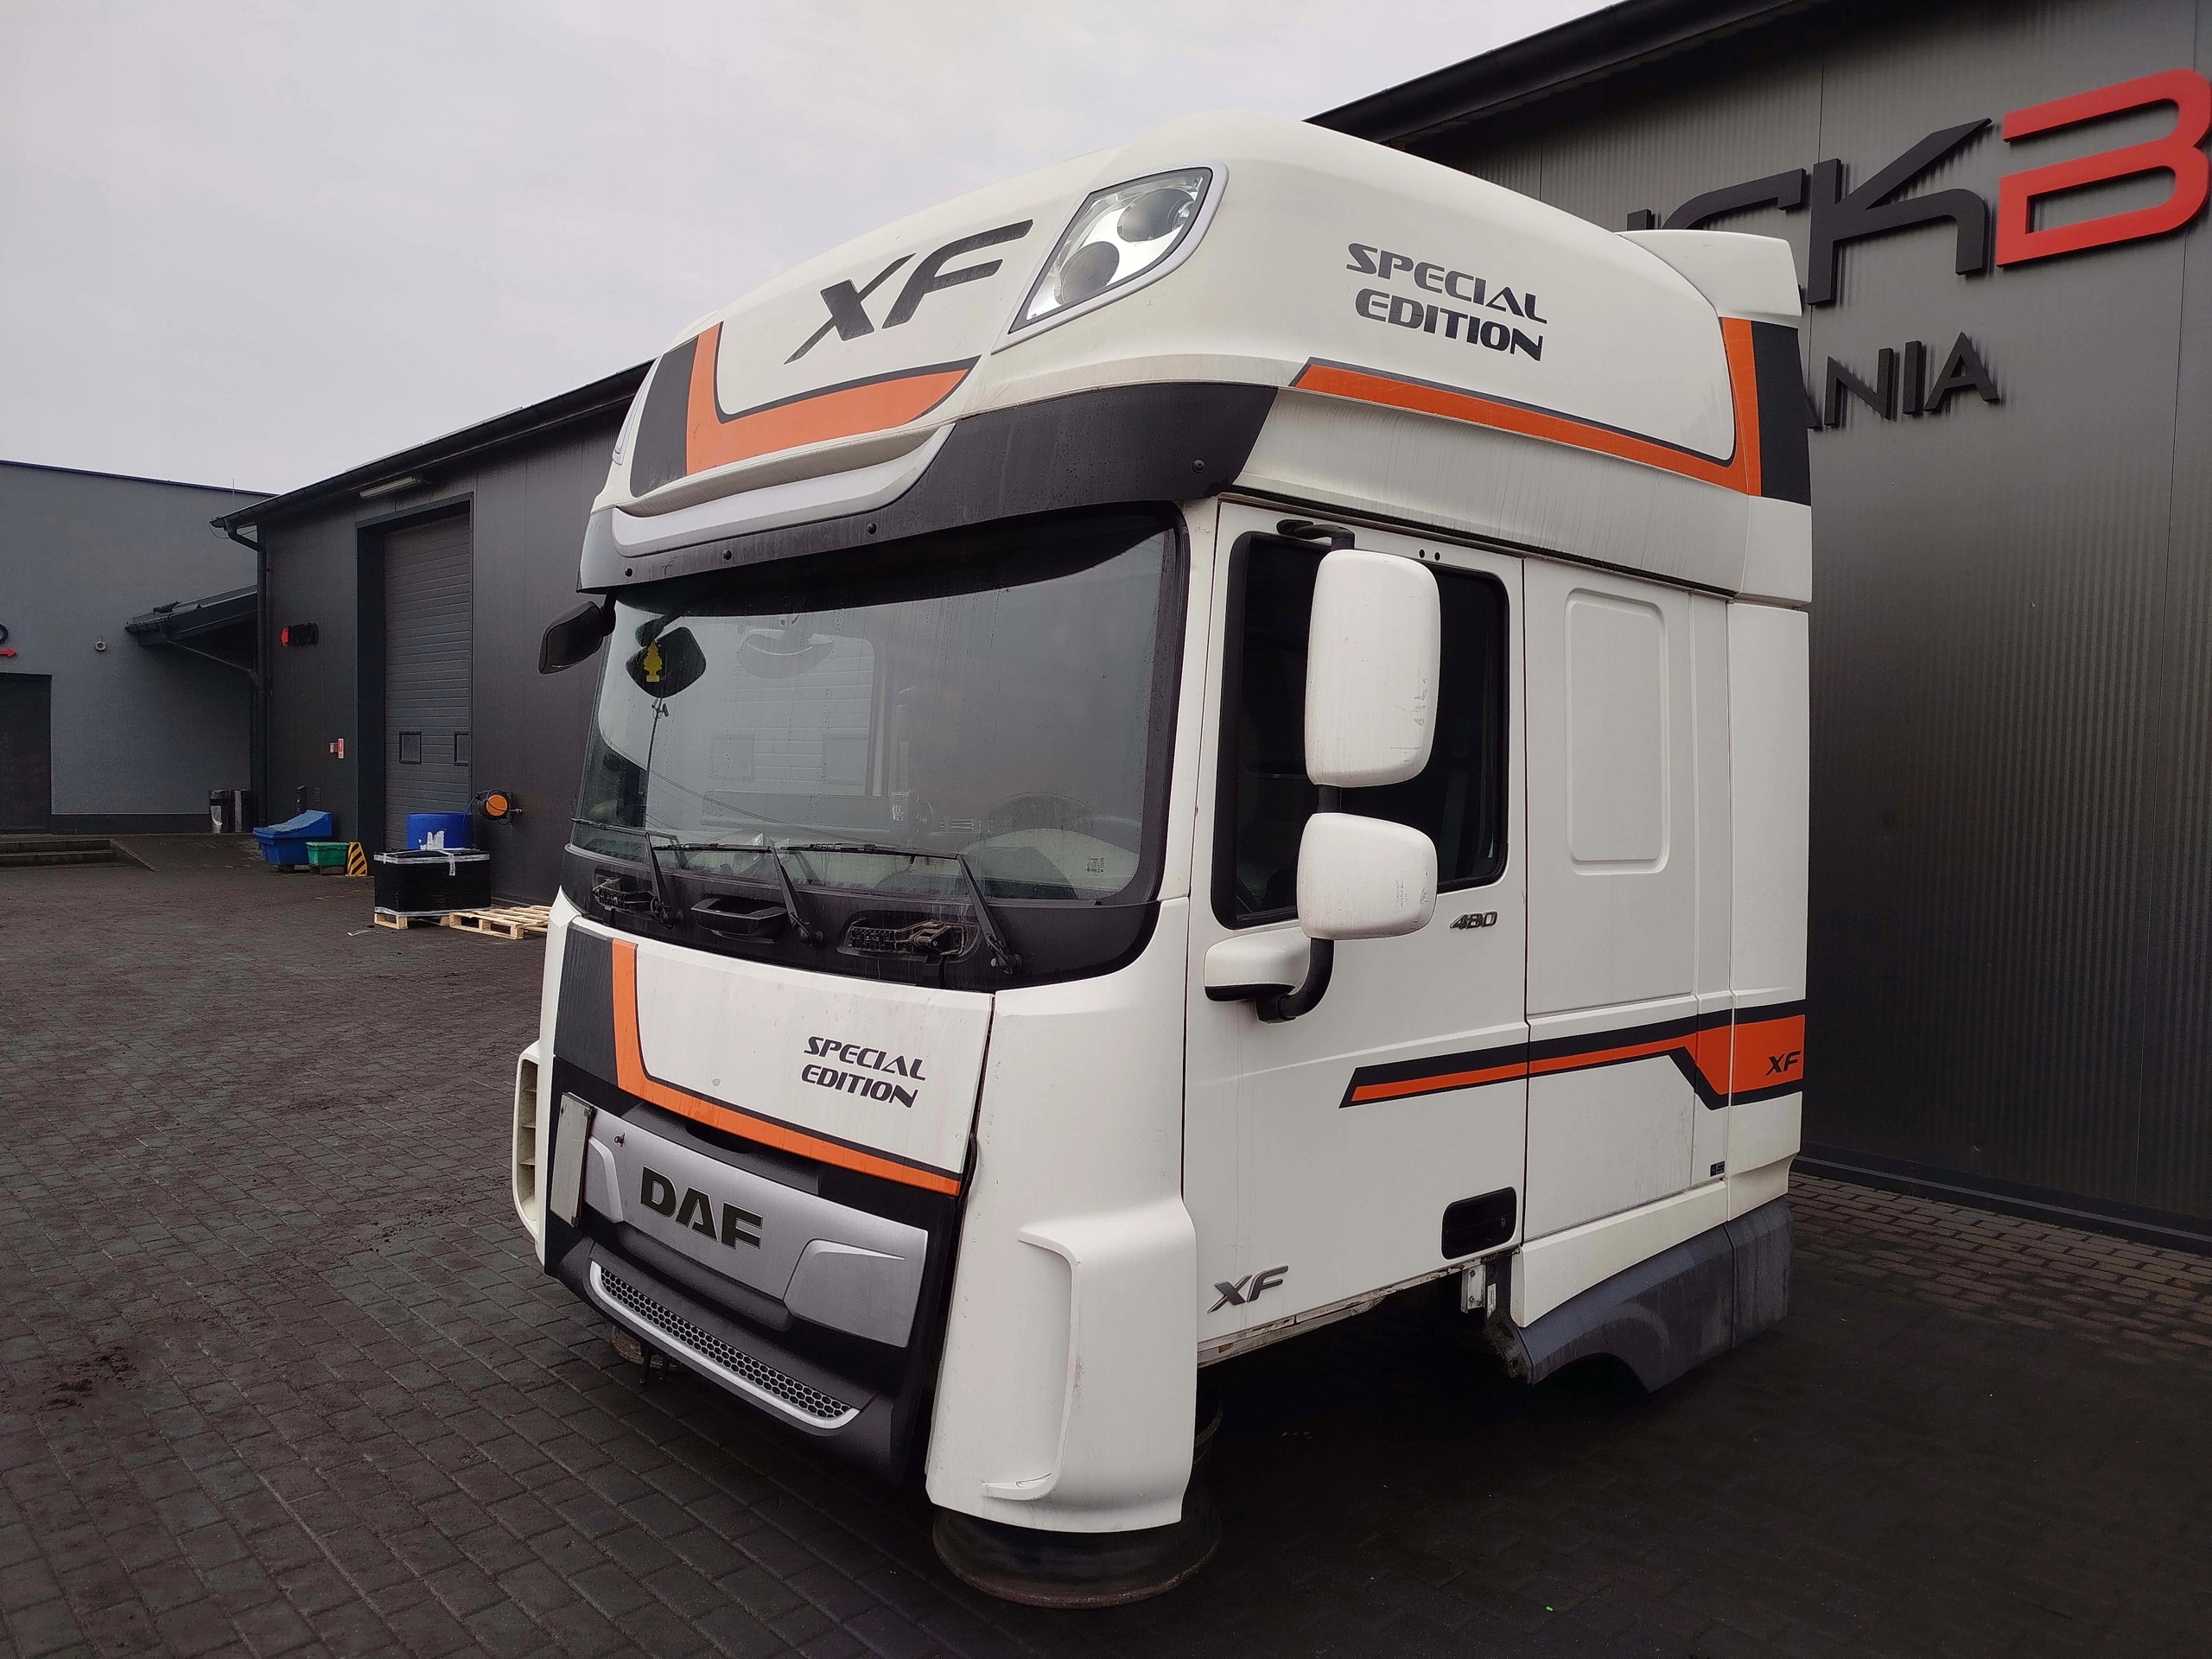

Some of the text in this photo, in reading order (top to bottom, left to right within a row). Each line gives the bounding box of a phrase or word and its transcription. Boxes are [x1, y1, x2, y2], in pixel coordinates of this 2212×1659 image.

[783, 219, 1033, 365] XF
[1346, 243, 1548, 325] SPECIAL
[1355, 288, 1544, 362] EDITION
[1808, 332, 2000, 429] NIA
[1450, 911, 1498, 930] 480
[801, 1064, 919, 1109] EDITION
[804, 1036, 926, 1081] SPECIAL
[1764, 1050, 1802, 1077] XF
[640, 1165, 763, 1250] DAF
[1207, 1265, 1289, 1313] XF
